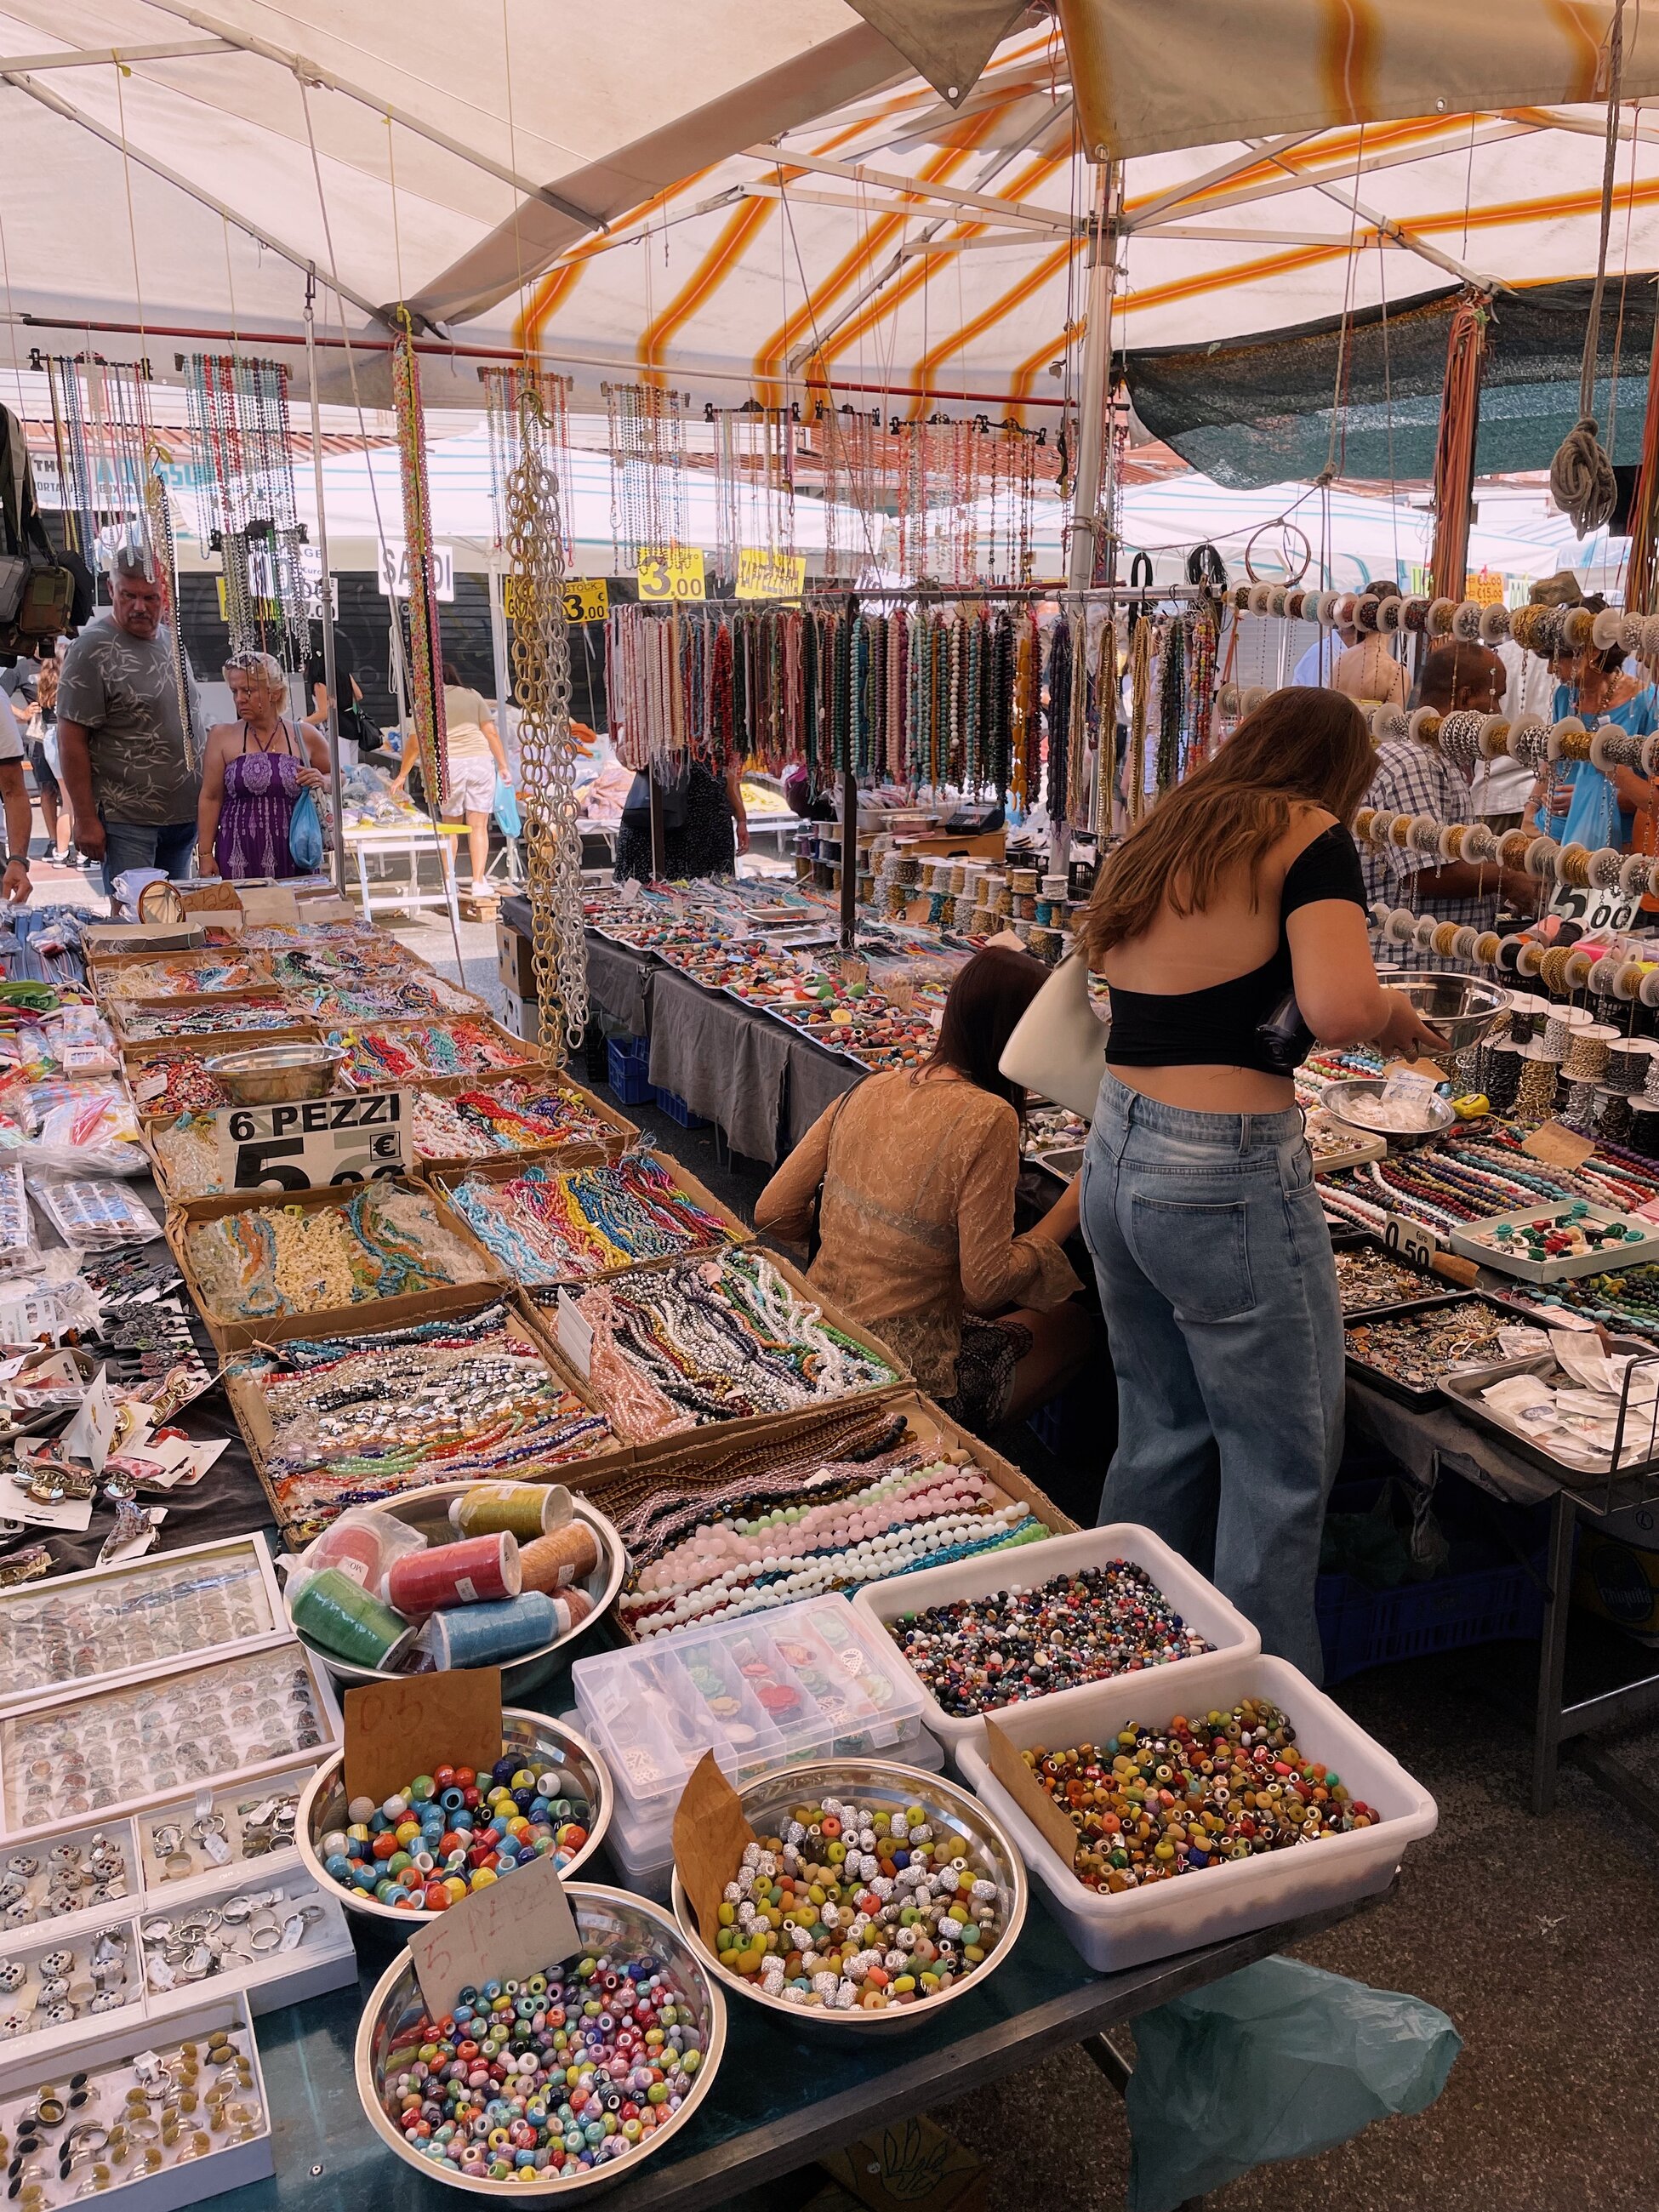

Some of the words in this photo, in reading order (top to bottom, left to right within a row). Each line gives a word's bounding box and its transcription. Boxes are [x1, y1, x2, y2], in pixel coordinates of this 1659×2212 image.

[229, 1111, 255, 1141] 6
[271, 1092, 401, 1137] PEZZI
[1416, 1230, 1428, 1243] Euro
